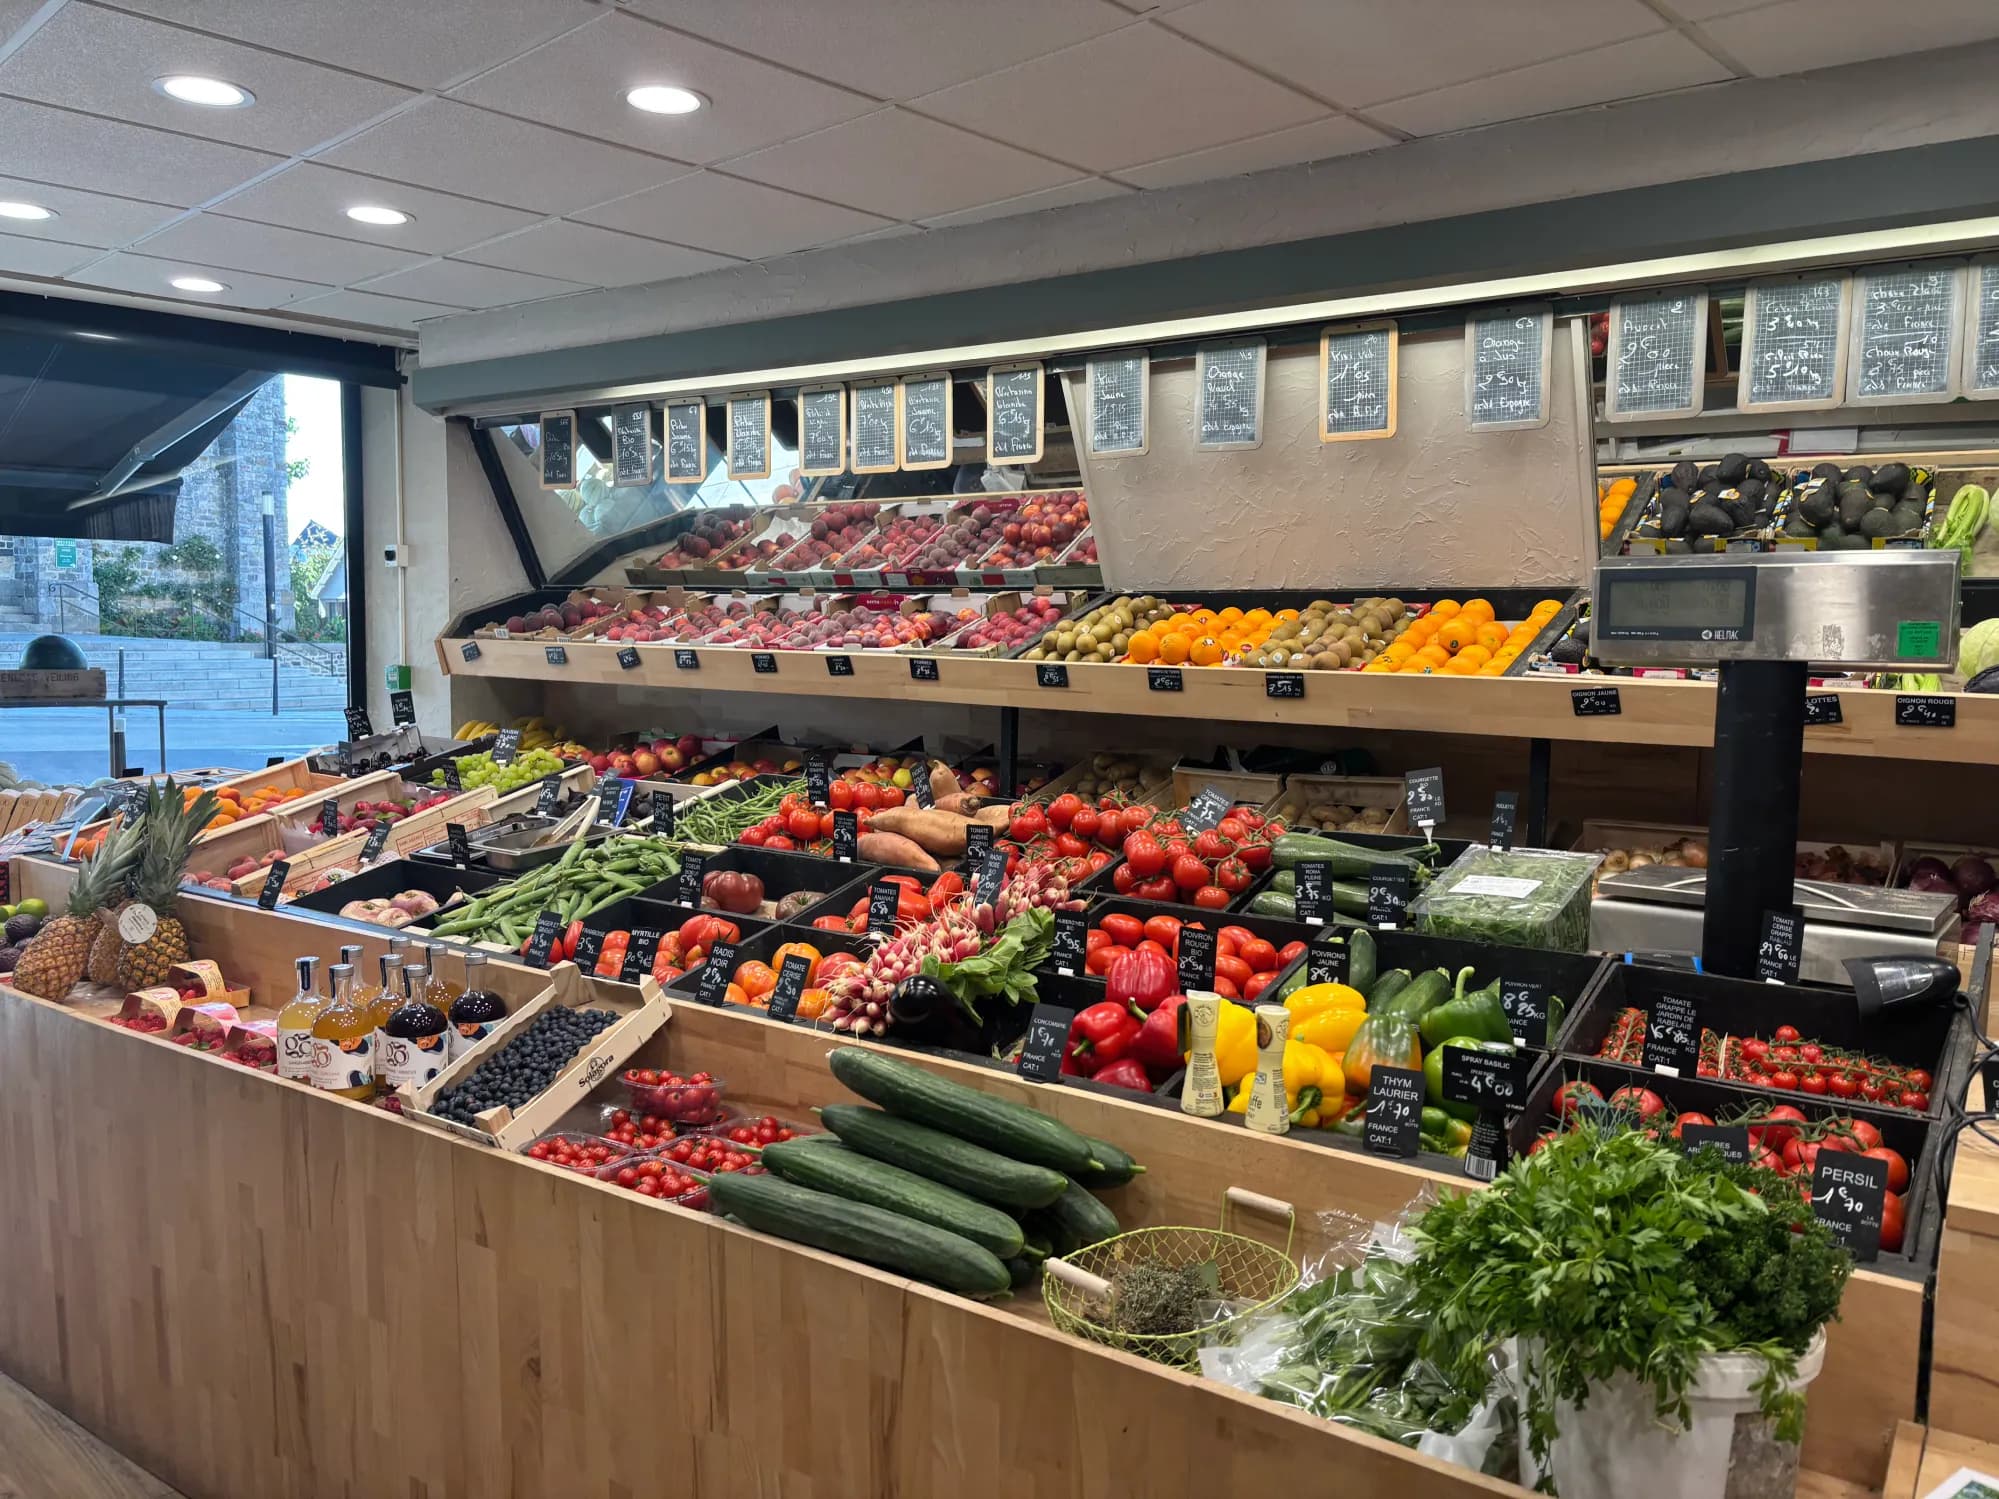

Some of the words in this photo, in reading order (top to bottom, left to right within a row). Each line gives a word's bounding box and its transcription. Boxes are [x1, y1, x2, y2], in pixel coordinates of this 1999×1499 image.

[1772, 915, 1795, 926] TOMATE
[631, 929, 661, 939] MYRTILLE
[1182, 930, 1214, 942] POIVRON
[638, 938, 650, 946] BIO
[1184, 939, 1210, 950] ROUGE
[712, 946, 735, 959] RADIS
[1053, 950, 1073, 959] FRANCE
[1190, 949, 1203, 957] BIO
[1311, 949, 1347, 960] POIVRONS
[710, 957, 729, 969] NOIR
[785, 960, 807, 973] TOMATE
[1317, 958, 1340, 967] JAUNE
[1759, 958, 1783, 969] FRANCE
[1662, 996, 1693, 1007] TOMATE
[1533, 1011, 1546, 1019] KG
[1655, 1002, 1686, 1015] GRAPPE
[1687, 1009, 1697, 1017] LE
[1656, 1010, 1683, 1021] JARDIN
[1683, 1015, 1695, 1023] DE
[1033, 1017, 1067, 1030] CONCOMBRE
[1656, 1017, 1693, 1030] RABELAIS
[1646, 1042, 1678, 1055] FRANCE
[1684, 1046, 1696, 1054] KG
[1022, 1052, 1046, 1063] FRANCE
[1461, 1055, 1483, 1065] SPRAY
[1484, 1058, 1511, 1070] BASILIC
[1382, 1075, 1413, 1089] THYM
[1373, 1086, 1419, 1102] LAURIER
[1367, 1121, 1399, 1134] FRANCE
[1821, 1166, 1879, 1190] PERSIL
[1813, 1216, 1853, 1233] FRANCE
